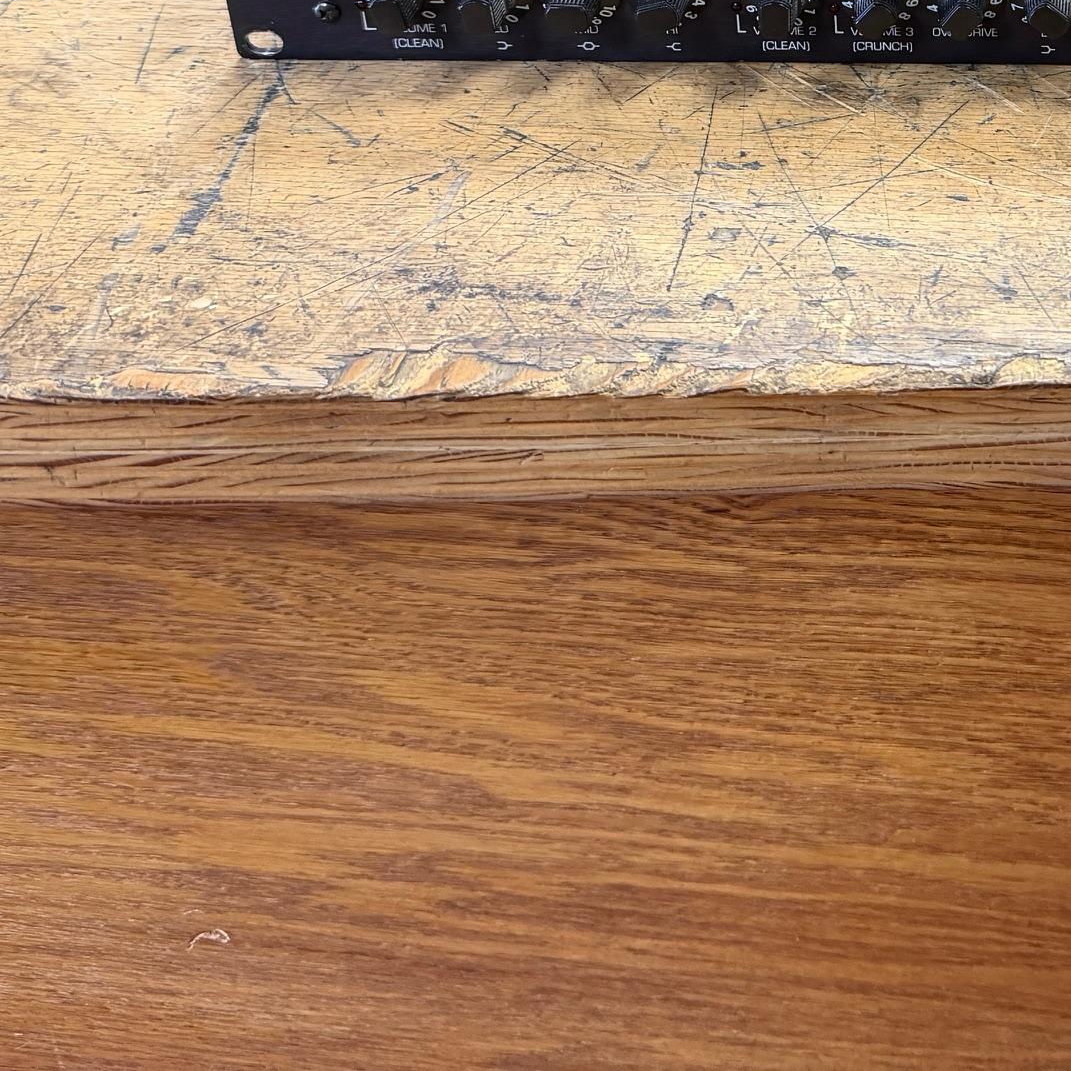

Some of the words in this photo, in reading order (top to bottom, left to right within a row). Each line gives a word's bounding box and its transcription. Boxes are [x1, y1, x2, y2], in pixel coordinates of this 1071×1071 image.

[441, 23, 447, 32] 1
[394, 38, 444, 49] (CLEAN)
[762, 41, 810, 51] (CLEAN)
[853, 42, 912, 52] (CRUNCH)
